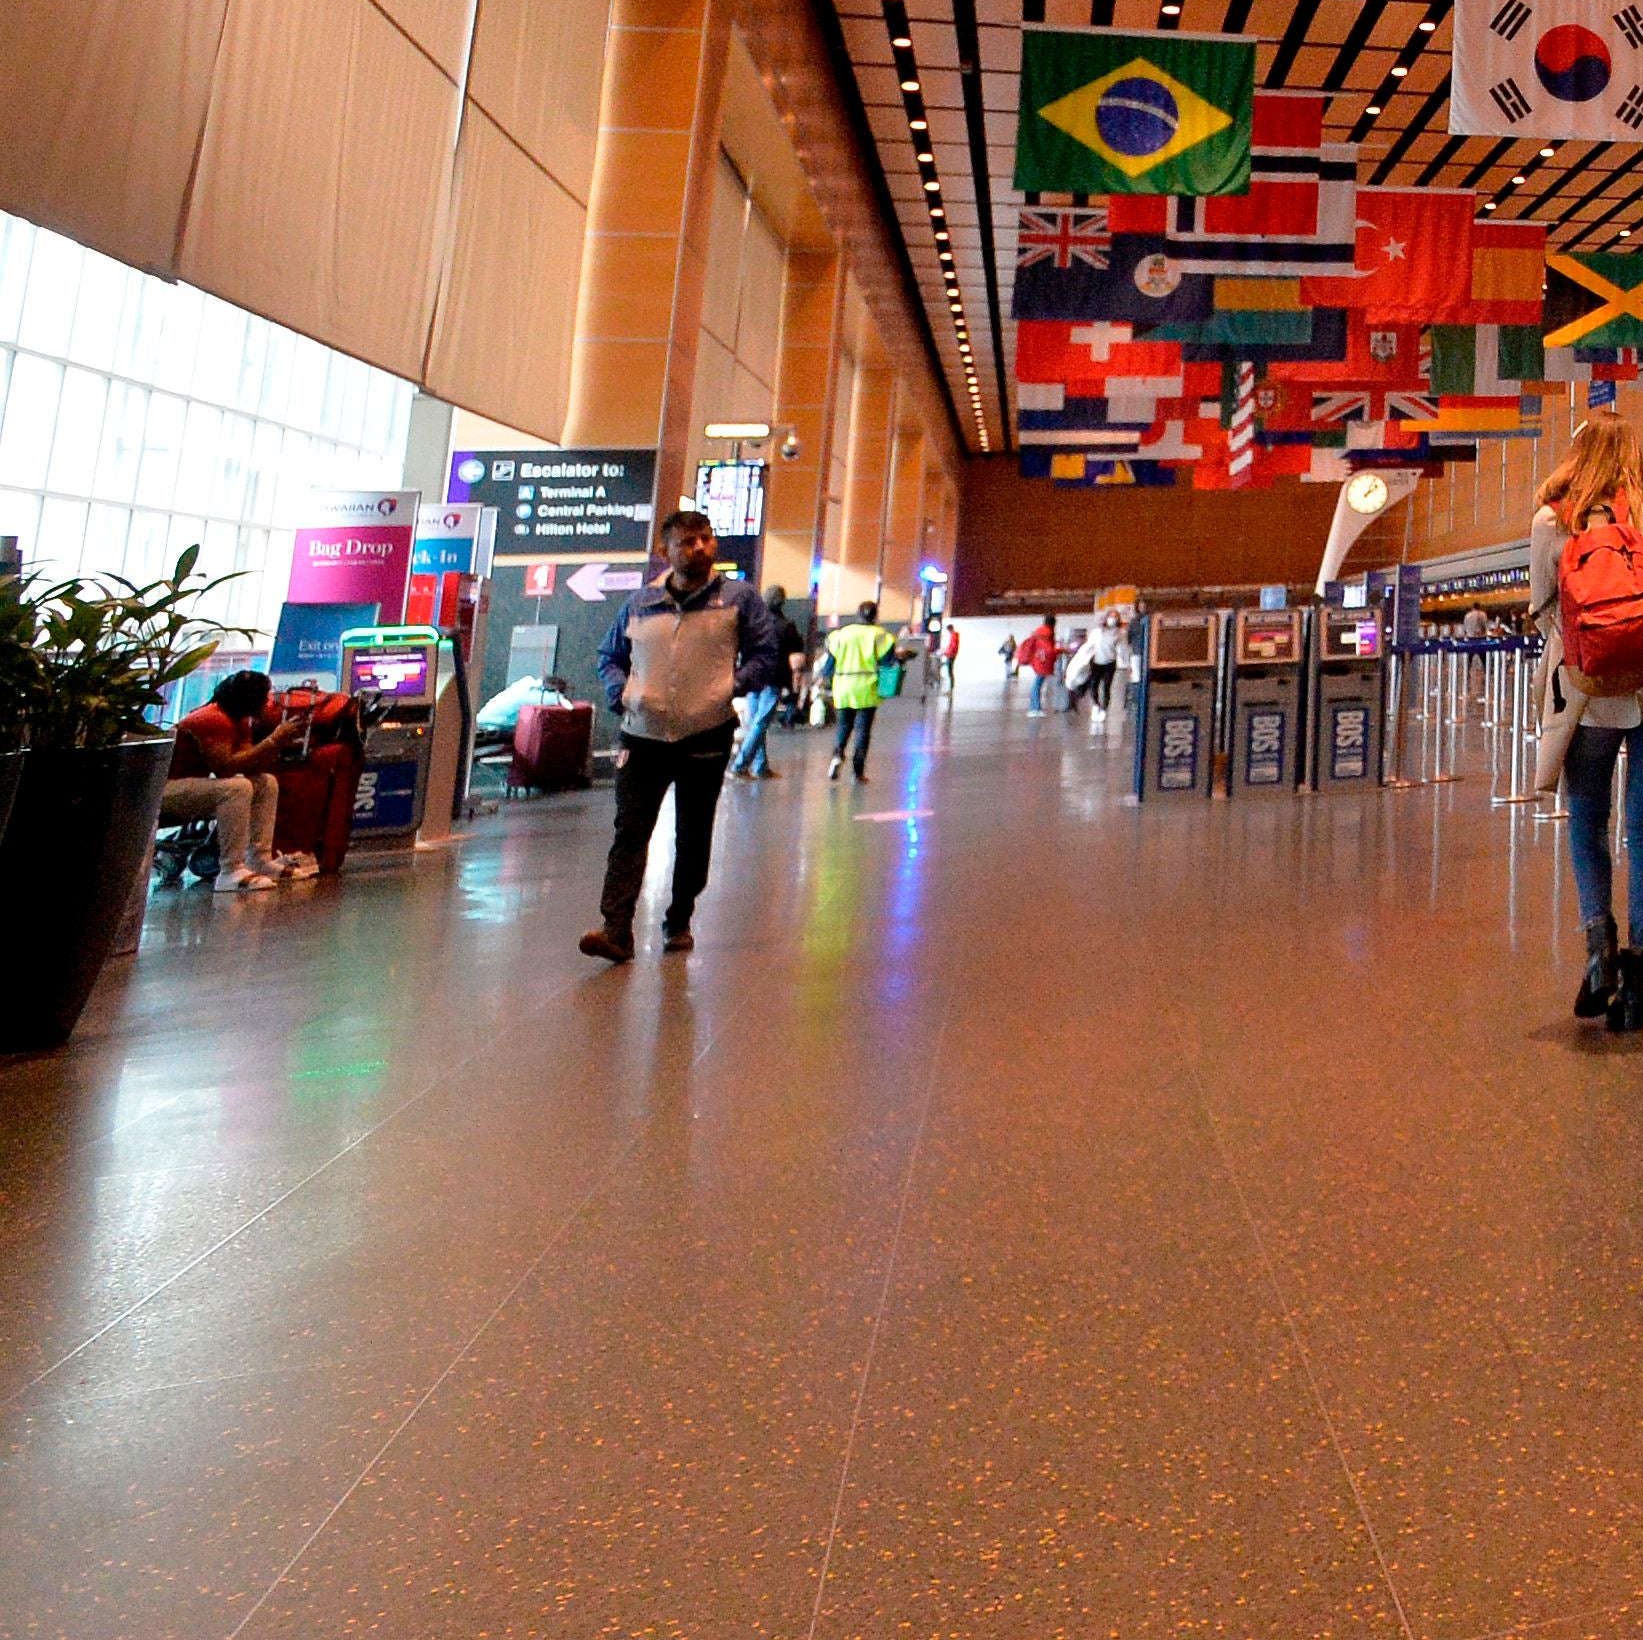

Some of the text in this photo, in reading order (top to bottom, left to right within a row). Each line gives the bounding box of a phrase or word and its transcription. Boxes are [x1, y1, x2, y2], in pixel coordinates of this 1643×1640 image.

[520, 462, 625, 478] Escalator to:
[540, 485, 606, 499] Terminal A
[537, 504, 635, 520] Central Parking
[535, 522, 611, 536] Hilton Hotel
[309, 538, 394, 558] Bag Drop
[1252, 715, 1282, 753] BOS
[1337, 711, 1364, 747] BOS
[1164, 720, 1195, 758] BOS
